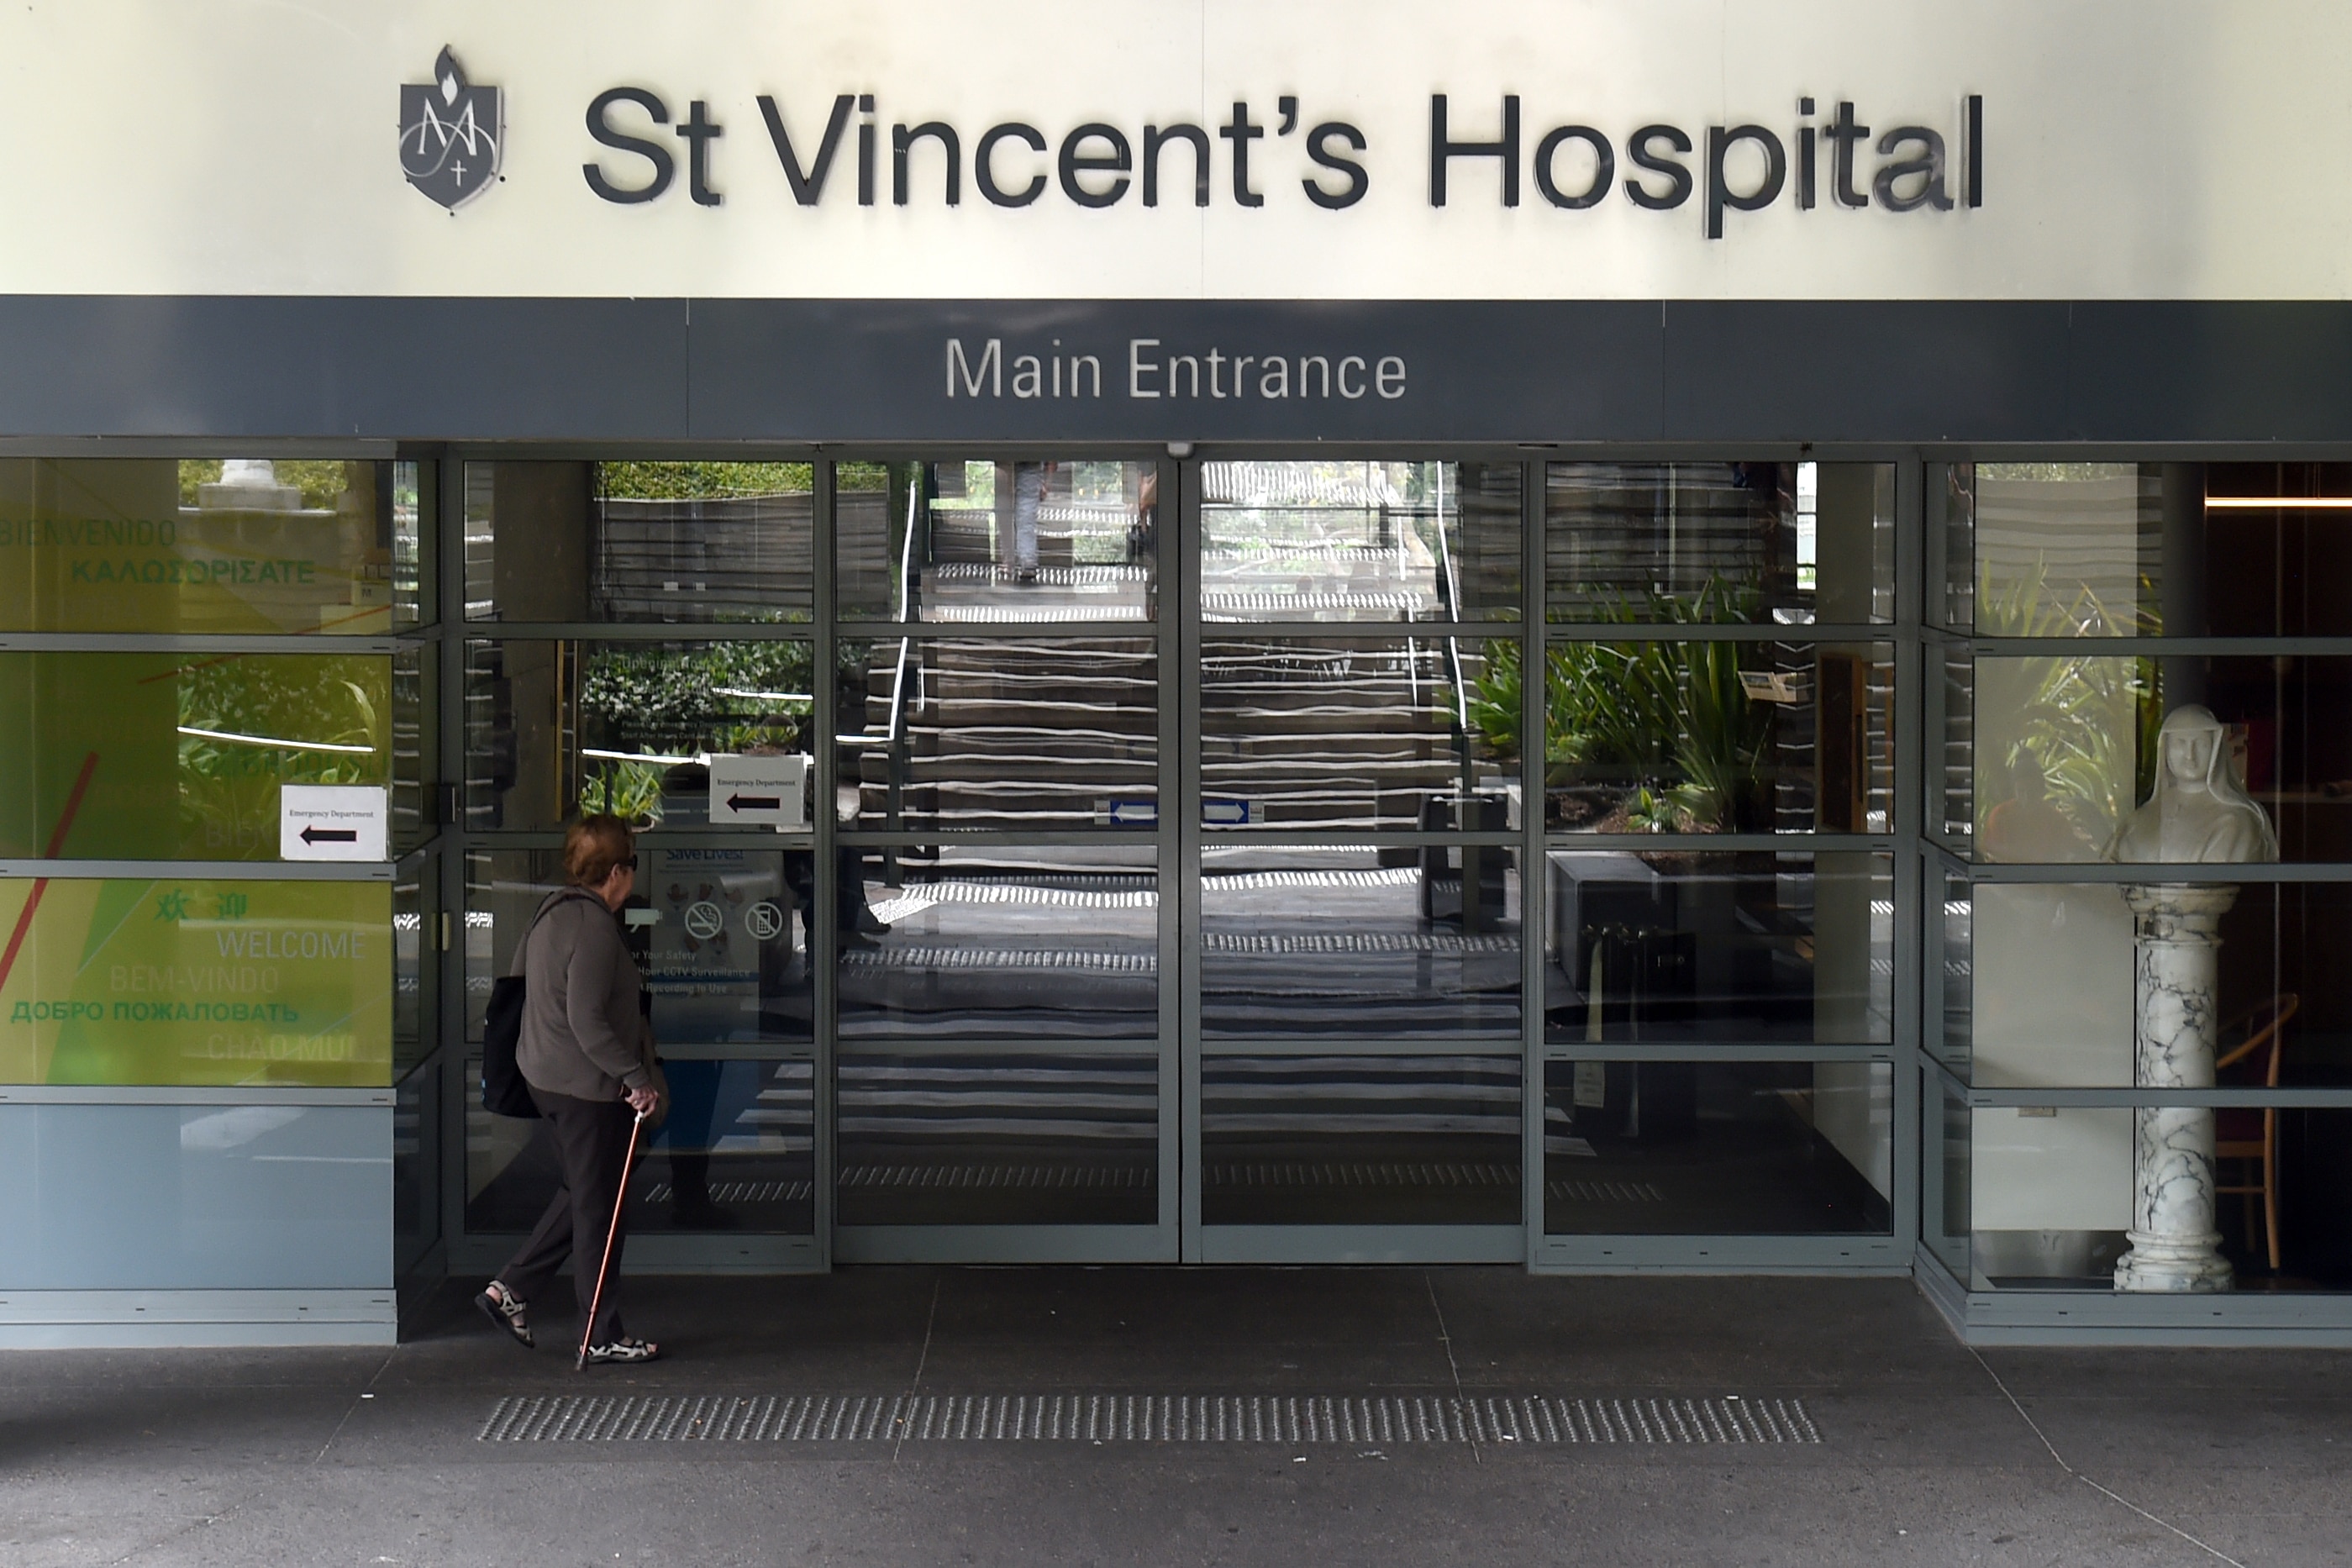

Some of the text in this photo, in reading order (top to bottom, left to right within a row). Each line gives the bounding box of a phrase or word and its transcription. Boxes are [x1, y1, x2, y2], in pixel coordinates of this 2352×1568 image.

[581, 86, 723, 208] St
[1431, 93, 1983, 239] Hospital
[945, 339, 1407, 399] Main Entrance
[716, 778, 797, 788] Emergency Department
[289, 809, 375, 819] Emergency Department
[216, 929, 366, 960] WELCOME
[642, 950, 663, 960] Your
[666, 950, 697, 962] Safety
[110, 966, 280, 993] BEM-VINDO
[663, 967, 689, 976] CCTV
[692, 967, 751, 976] Surveillance
[645, 983, 694, 994] Recording
[708, 983, 727, 993] Use
[10, 1001, 299, 1023] ДОБРО ПОЖАЛОВАТЬ
